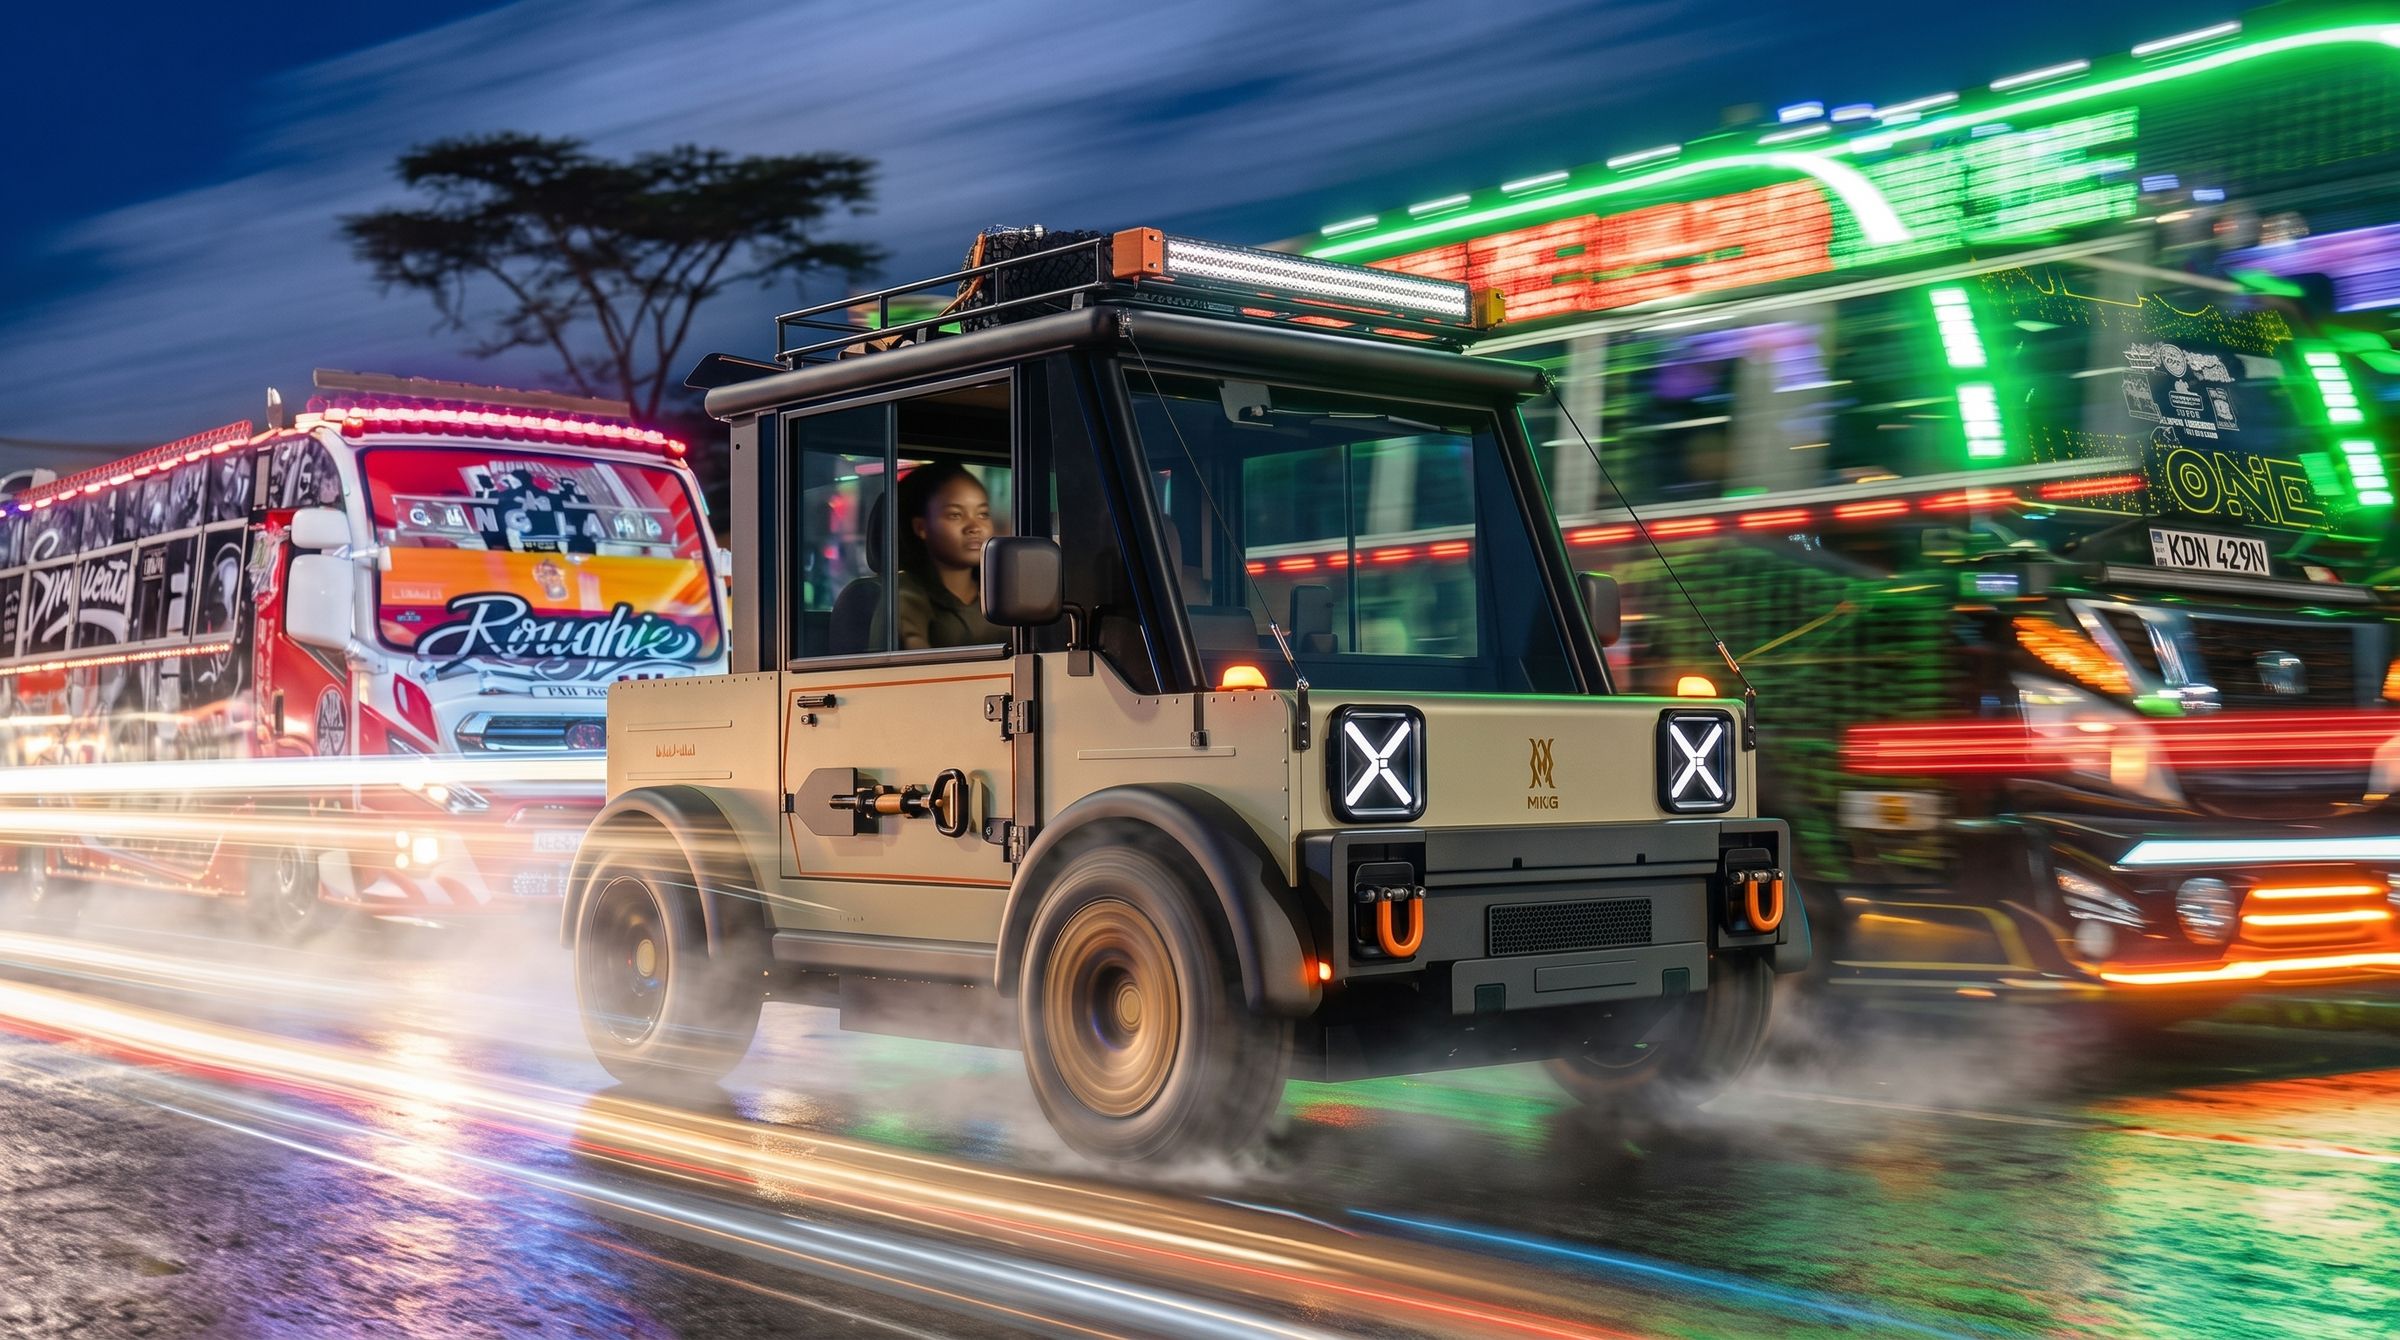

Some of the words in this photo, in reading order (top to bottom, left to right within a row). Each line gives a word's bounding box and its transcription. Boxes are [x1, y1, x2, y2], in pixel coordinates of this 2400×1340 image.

[2167, 449, 2329, 530] ONE
[2167, 534, 2210, 568] KDN
[2217, 539, 2265, 572] 429N
[417, 595, 697, 680] Roughie
[1527, 796, 1558, 809] MKG
